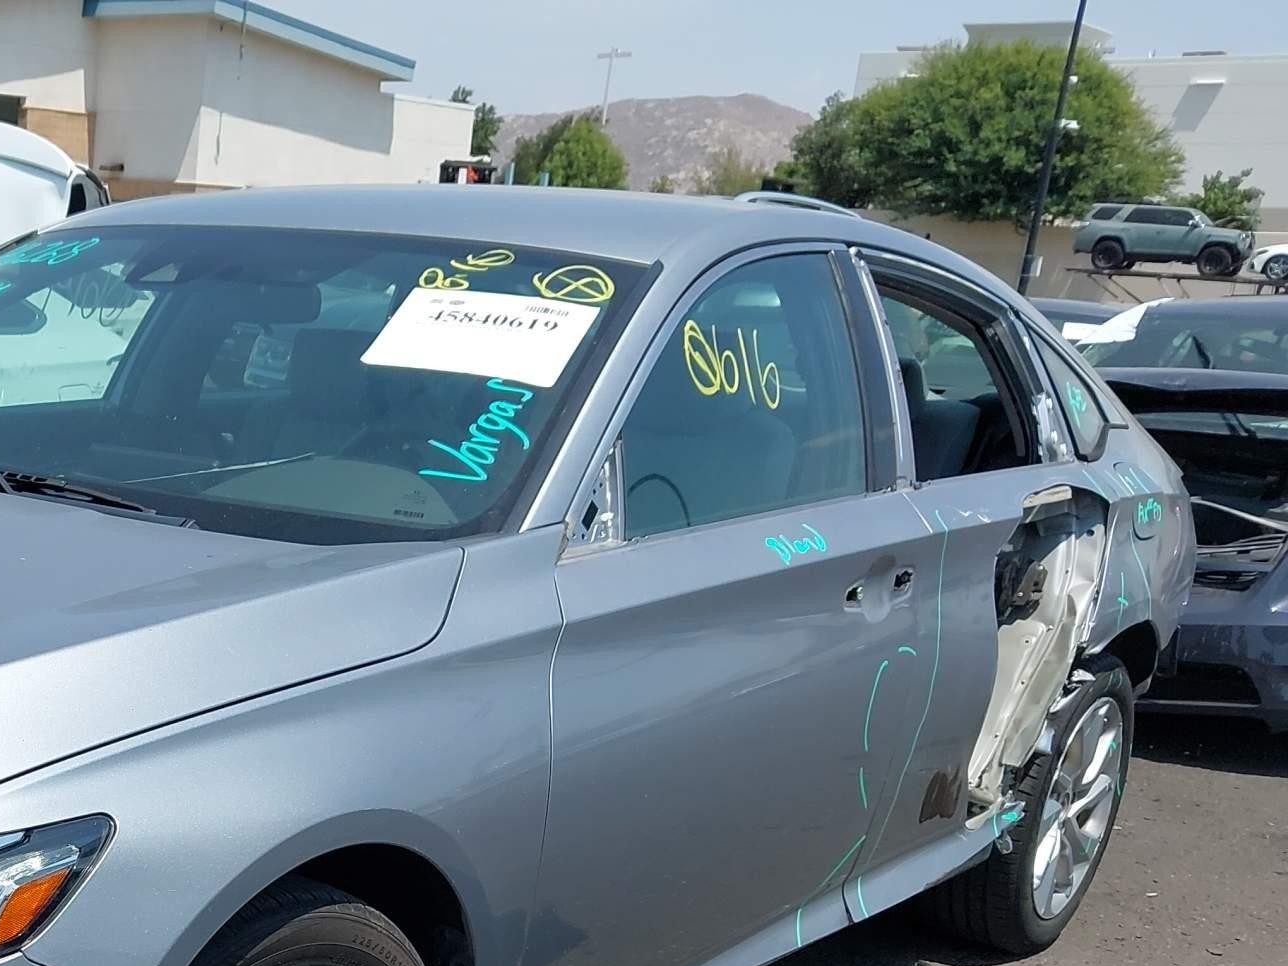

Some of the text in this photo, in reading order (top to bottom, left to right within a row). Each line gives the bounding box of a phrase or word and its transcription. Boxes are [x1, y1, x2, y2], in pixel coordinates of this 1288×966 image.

[428, 309, 559, 332] 45840619
[684, 319, 780, 410] 0616
[418, 378, 534, 481] Vargas
